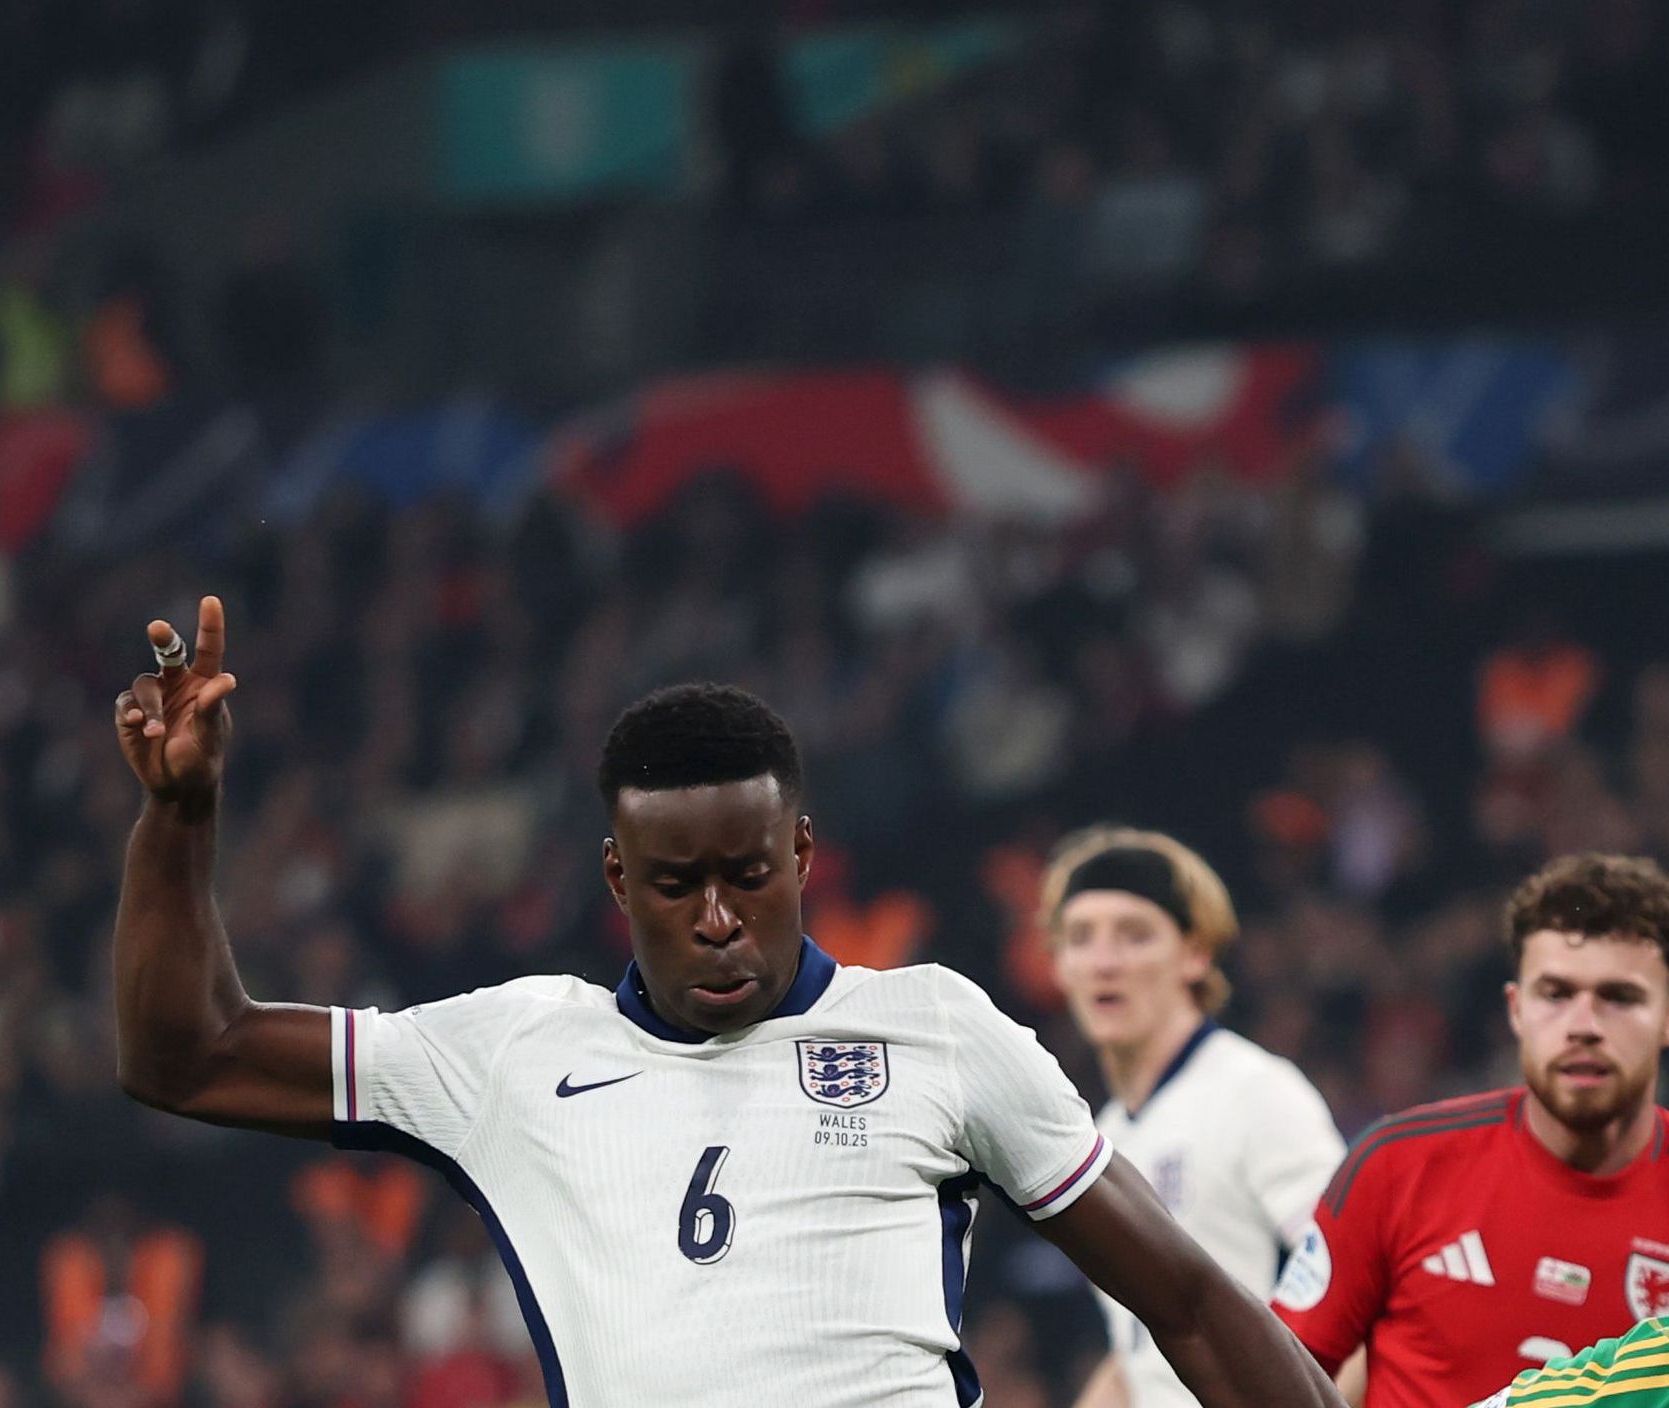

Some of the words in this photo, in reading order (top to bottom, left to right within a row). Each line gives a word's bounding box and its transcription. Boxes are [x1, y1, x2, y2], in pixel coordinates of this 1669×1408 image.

[819, 1114, 866, 1131] WALES
[814, 1131, 868, 1147] 09.10.25
[678, 1145, 736, 1265] 6
